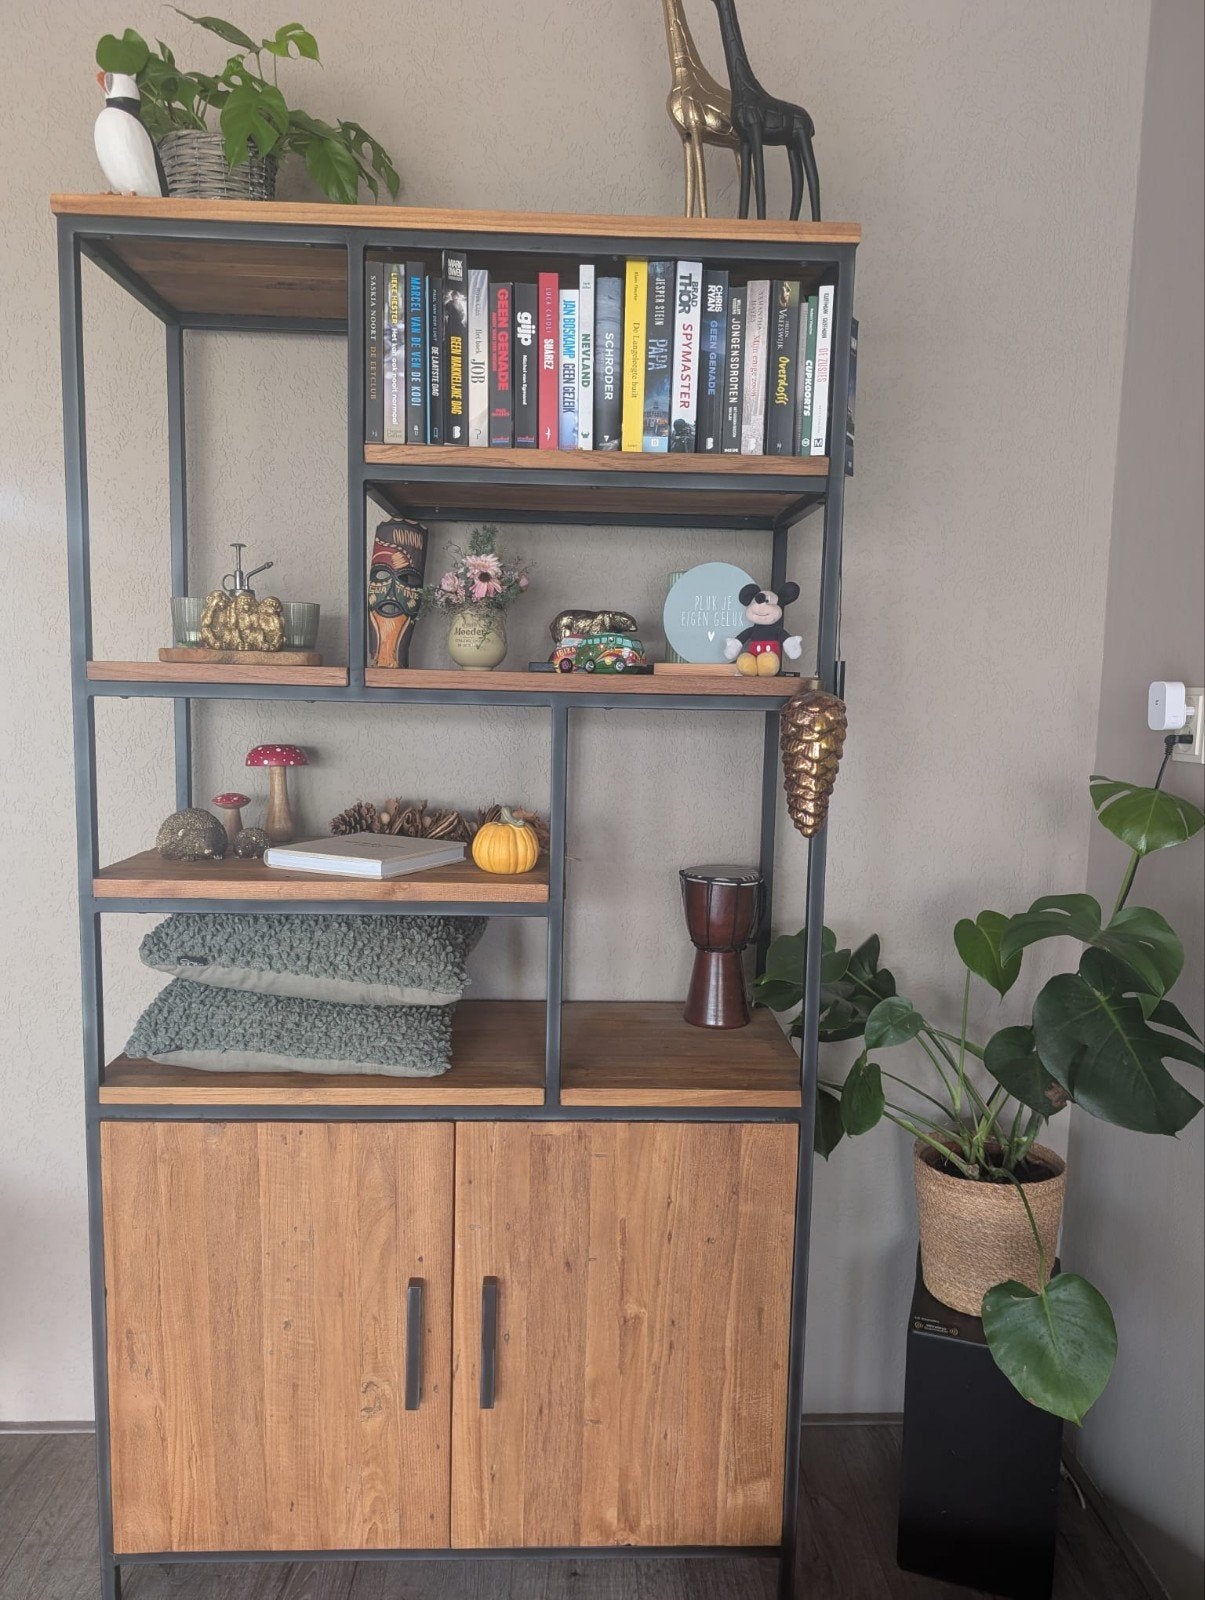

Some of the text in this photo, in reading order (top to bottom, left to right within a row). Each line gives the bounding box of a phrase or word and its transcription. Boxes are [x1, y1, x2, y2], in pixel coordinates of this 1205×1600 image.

[654, 277, 665, 326] JESPER STEIN
[678, 273, 692, 314] THOR
[707, 285, 716, 312] RYAN
[715, 285, 723, 313] CHRIS
[410, 276, 421, 368] MARCEL VAN DE VEN
[497, 288, 509, 391] GEEN GENADE
[517, 312, 535, 346] gijp
[563, 300, 576, 359] JAN BOSKAMP
[632, 322, 640, 334] De
[370, 346, 377, 358] DE
[431, 346, 439, 397] DE LAATSTE DAG
[471, 359, 485, 384] JOB
[544, 338, 554, 370] SUÁREZ
[582, 334, 590, 388] NEVLAND
[604, 333, 614, 400] SCHRODER
[648, 339, 668, 371] PAPA
[680, 323, 693, 409] SPYMASTER
[707, 320, 718, 396] GEEN GENADE
[728, 318, 741, 403] JONGENSDROMEN
[818, 348, 829, 357] DE
[411, 371, 422, 406] DE KOOI
[451, 336, 462, 415] GEEN MAKKELIJKE DAG
[563, 363, 576, 413] GEEN GEZEIK
[803, 360, 813, 416] CUPKOORTS
[681, 611, 744, 627] EIGEN GELUK
[694, 595, 732, 611] PLUK JE
[556, 647, 576, 657] IBIZA
